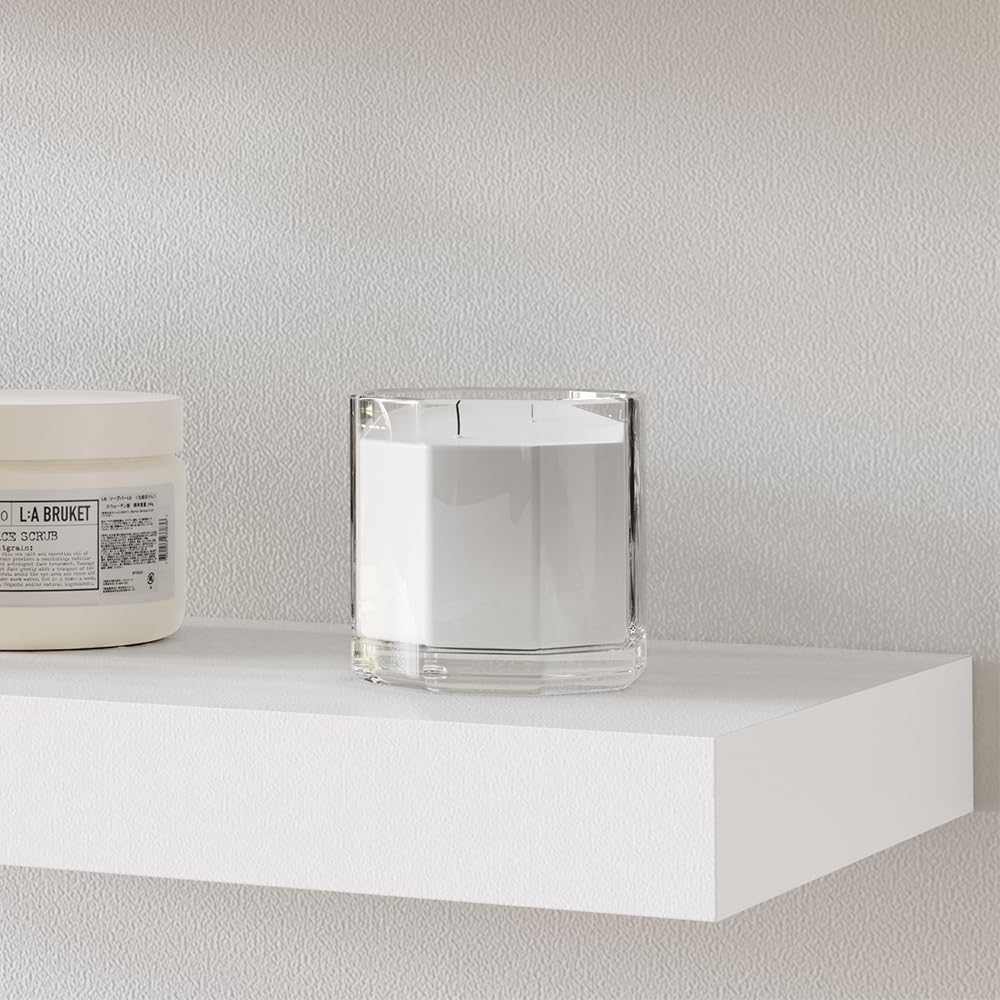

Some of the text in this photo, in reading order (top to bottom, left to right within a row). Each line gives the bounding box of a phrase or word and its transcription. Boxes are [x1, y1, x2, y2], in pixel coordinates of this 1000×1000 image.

[20, 506, 40, 522] L:A
[44, 505, 91, 522] BRUKET
[20, 530, 58, 542] SCRUB
